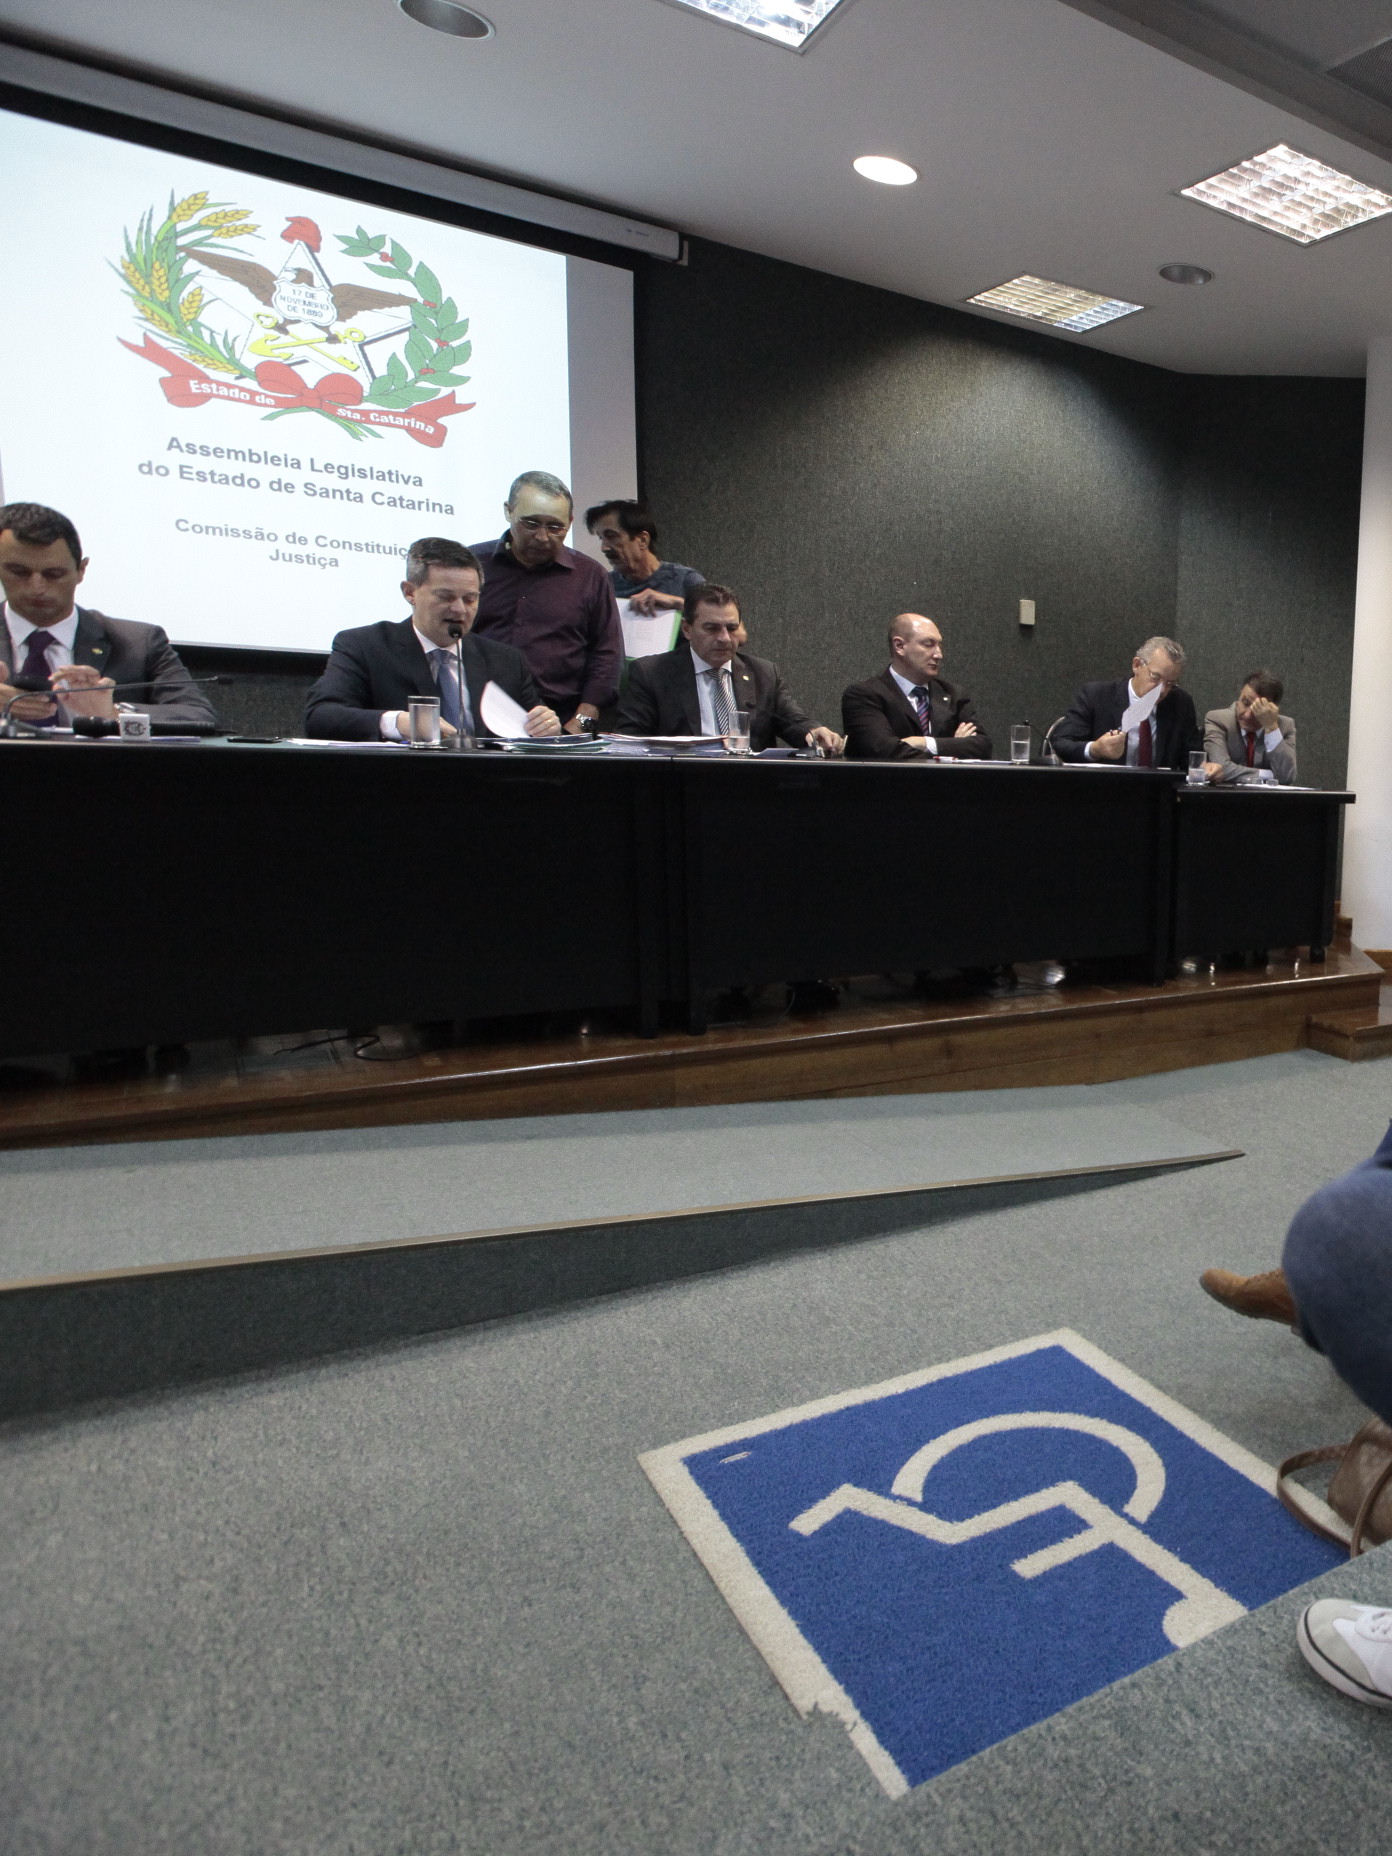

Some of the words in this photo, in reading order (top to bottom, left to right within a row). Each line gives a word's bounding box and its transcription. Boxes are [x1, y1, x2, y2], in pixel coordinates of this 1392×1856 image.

[292, 288, 302, 296] 17
[305, 291, 317, 299] DE
[287, 304, 299, 313] DE
[189, 379, 250, 401] Estado
[255, 393, 275, 406] de
[336, 407, 365, 421] Sta.
[369, 413, 435, 434] Catarina
[166, 436, 302, 470] Assembleia
[309, 457, 424, 487] Legislativa
[137, 460, 170, 477] do
[178, 464, 261, 489] Estado
[268, 476, 296, 494] de
[303, 482, 364, 504] Santa
[371, 491, 455, 515] Catarina
[174, 518, 279, 543] Comissão
[284, 531, 309, 545] de
[314, 534, 409, 560] Constituiç
[268, 548, 340, 570] Justiça
